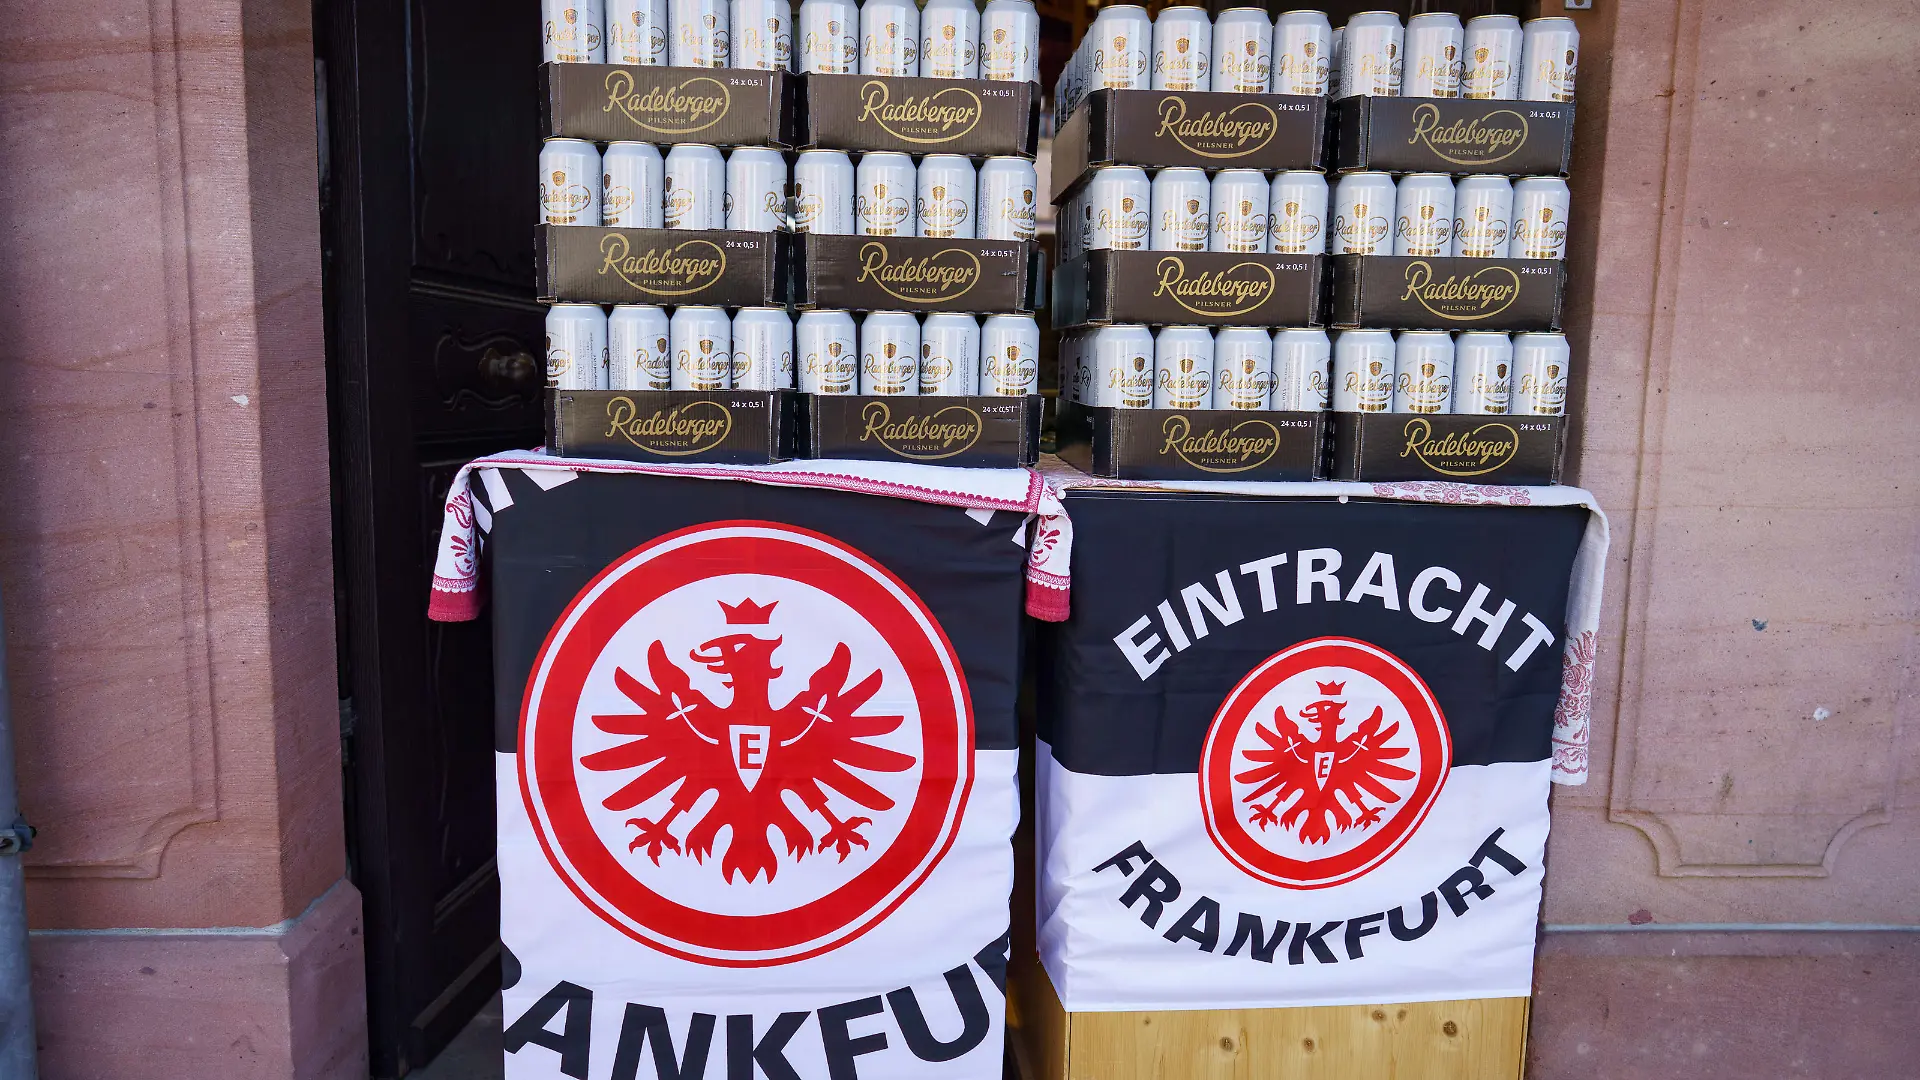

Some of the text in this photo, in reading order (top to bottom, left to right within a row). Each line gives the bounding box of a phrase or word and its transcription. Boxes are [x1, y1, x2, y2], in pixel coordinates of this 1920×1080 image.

[603, 70, 724, 122] Radeberger
[747, 79, 758, 87] 0,5
[999, 90, 1010, 98] 0,5
[858, 80, 975, 131] Radeberger
[1155, 95, 1271, 146] Radeberger
[1294, 104, 1306, 112] 0,5
[1545, 111, 1556, 119] 0,5
[1408, 103, 1521, 154] Radeberger
[1449, 148, 1484, 156] PILSNER
[598, 232, 719, 284] Radeberger
[743, 241, 754, 249] 0,5
[997, 250, 1008, 258] 0,5
[856, 241, 974, 292] Radeberger
[1153, 256, 1269, 304] Radeberger
[1292, 263, 1303, 272] 0,5
[1401, 260, 1512, 308] Radeberger
[1537, 267, 1548, 276] 0,5
[604, 396, 725, 444] Radeberger
[748, 401, 760, 409] 0,5
[859, 401, 975, 448] Radeberger
[999, 406, 1010, 414] 0,5
[1297, 420, 1308, 428] 0,5
[1159, 414, 1274, 461] Radeberger
[1400, 418, 1512, 464] Radeberger
[1536, 423, 1547, 432] 0,5
[1113, 547, 1554, 681] EINTRACHT
[739, 733, 763, 769] E
[1317, 757, 1330, 778] E
[1091, 826, 1527, 966] FRANKFURT
[502, 931, 1010, 1080] ANKFU
